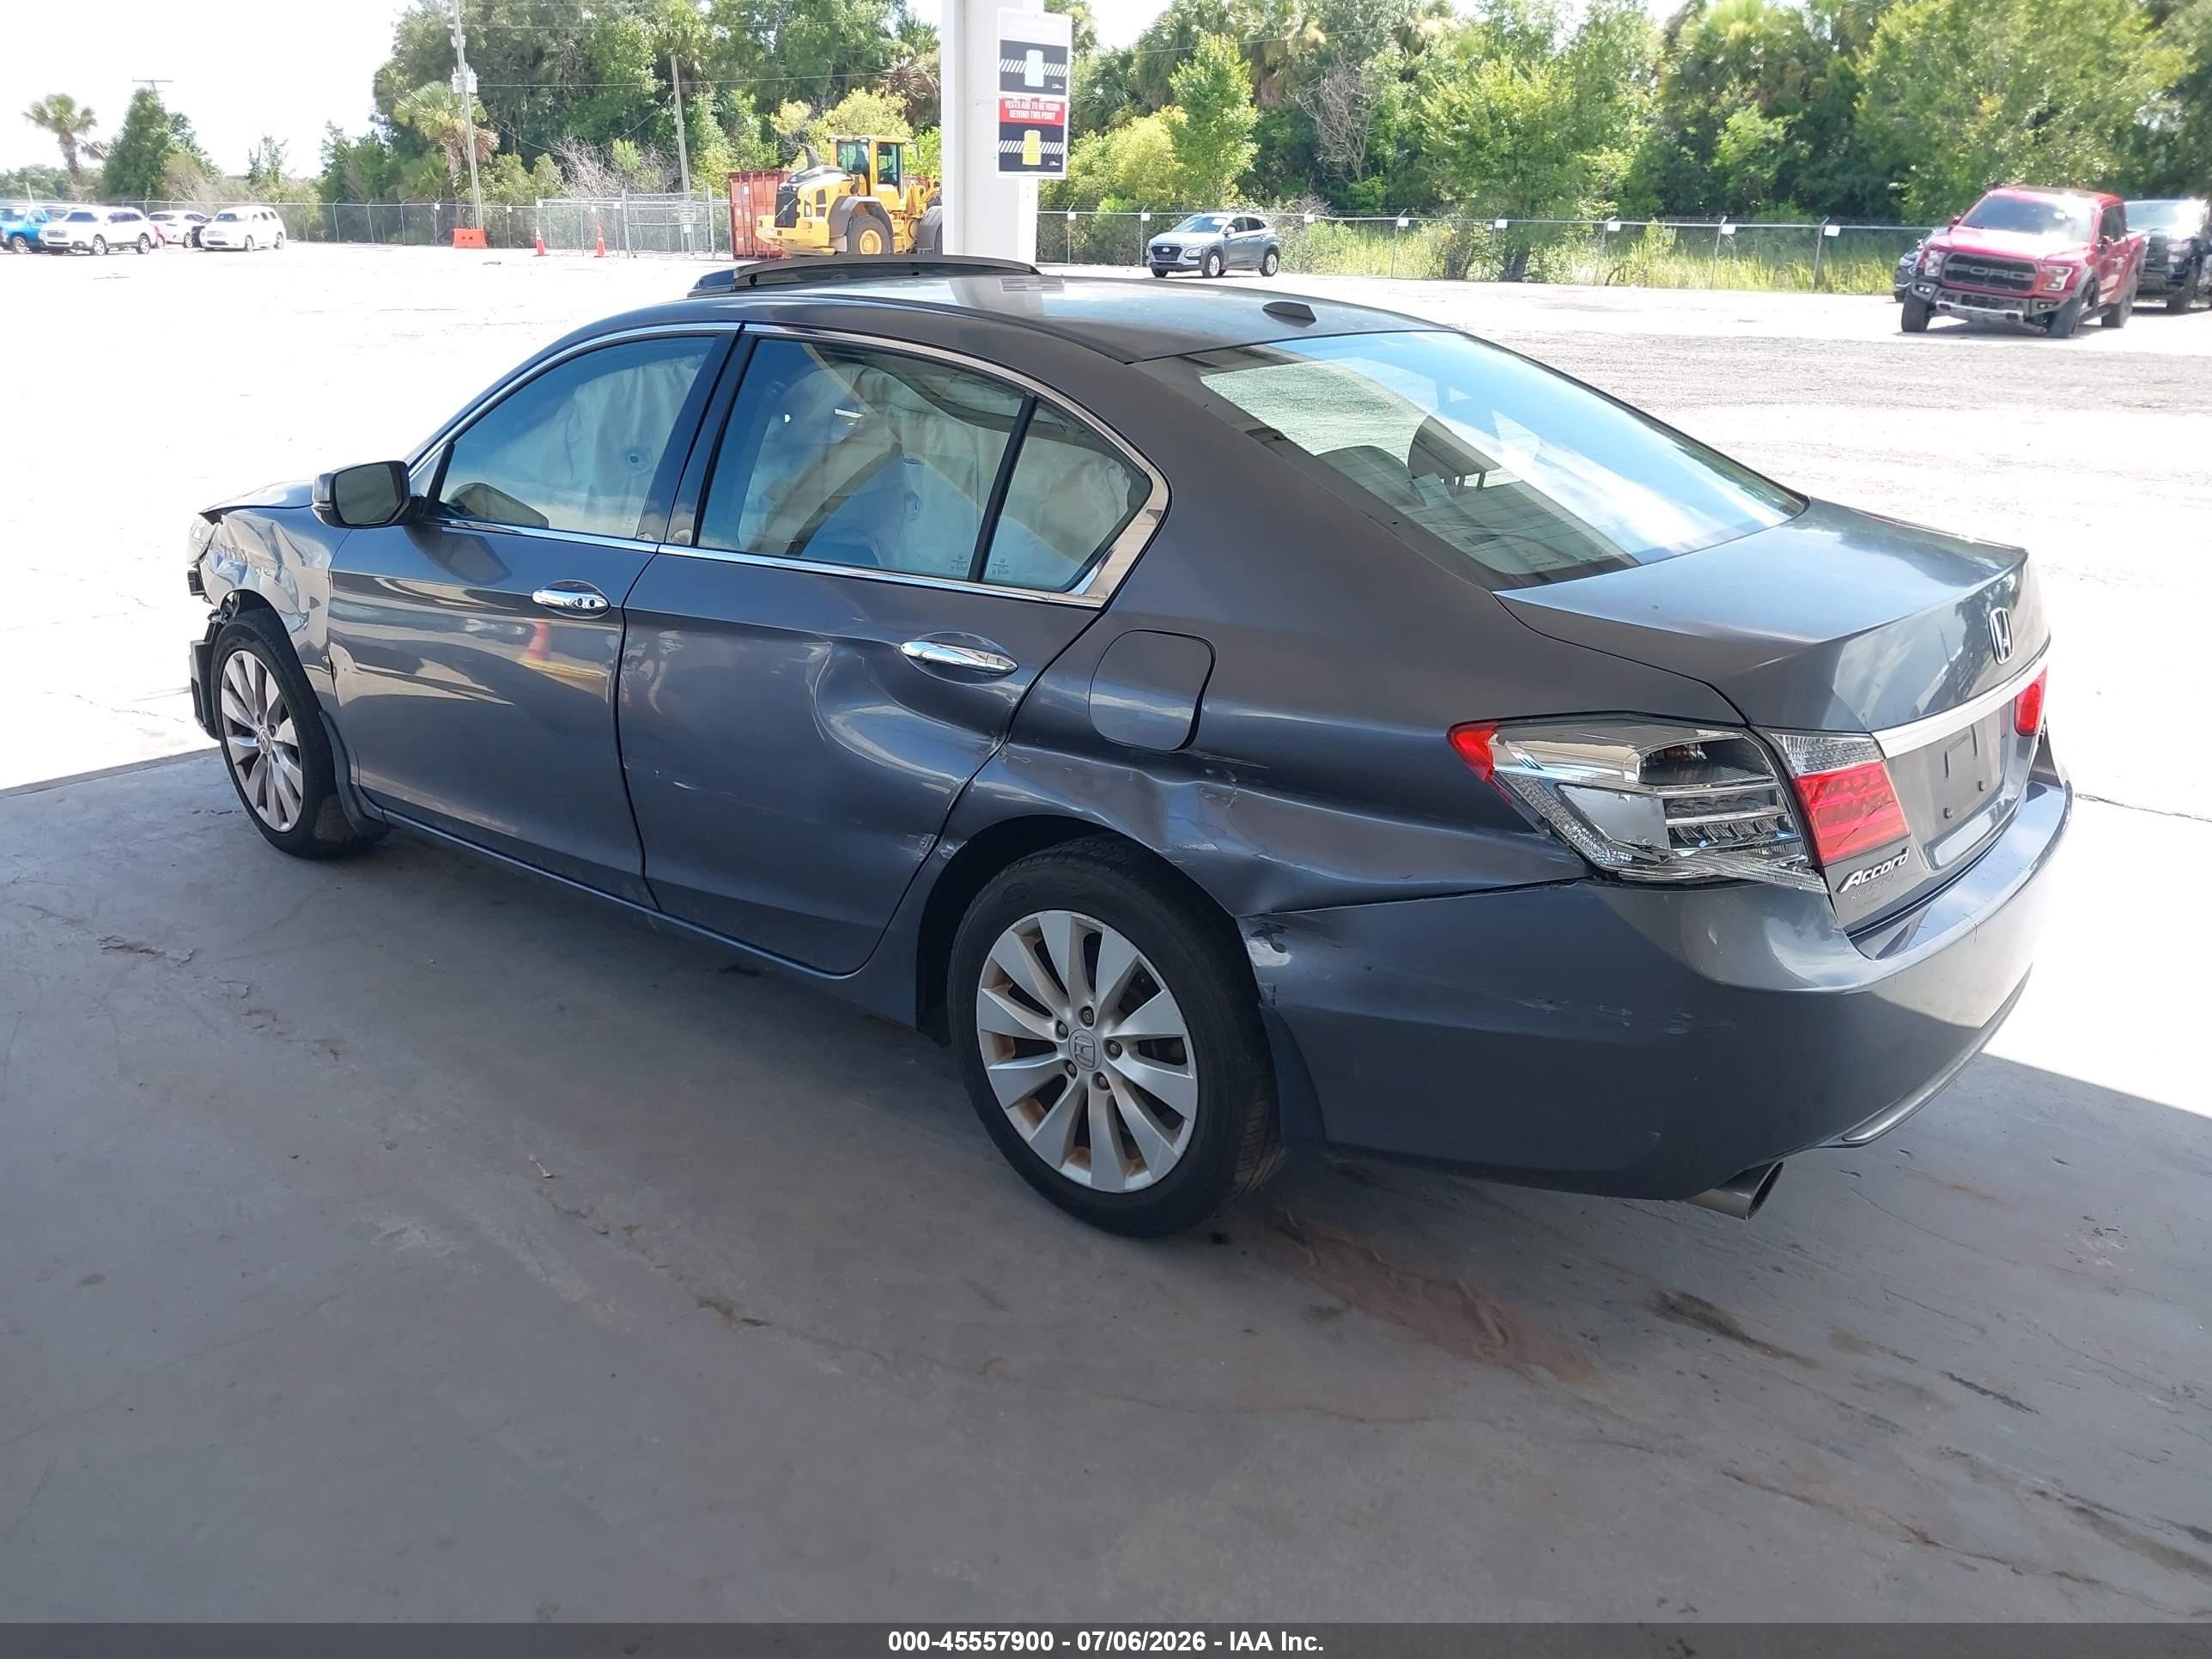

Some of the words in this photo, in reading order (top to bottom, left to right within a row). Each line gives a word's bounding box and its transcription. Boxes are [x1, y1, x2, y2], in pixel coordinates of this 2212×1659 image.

[1005, 100, 1020, 109] VESTS
[1021, 100, 1031, 110] ARE
[1031, 100, 1038, 111] TO
[1039, 101, 1045, 111] BE
[1009, 109, 1030, 118] BEYOND
[1030, 111, 1041, 119] THIS
[1946, 262, 2035, 281] FORD
[1838, 848, 1910, 894] Accord
